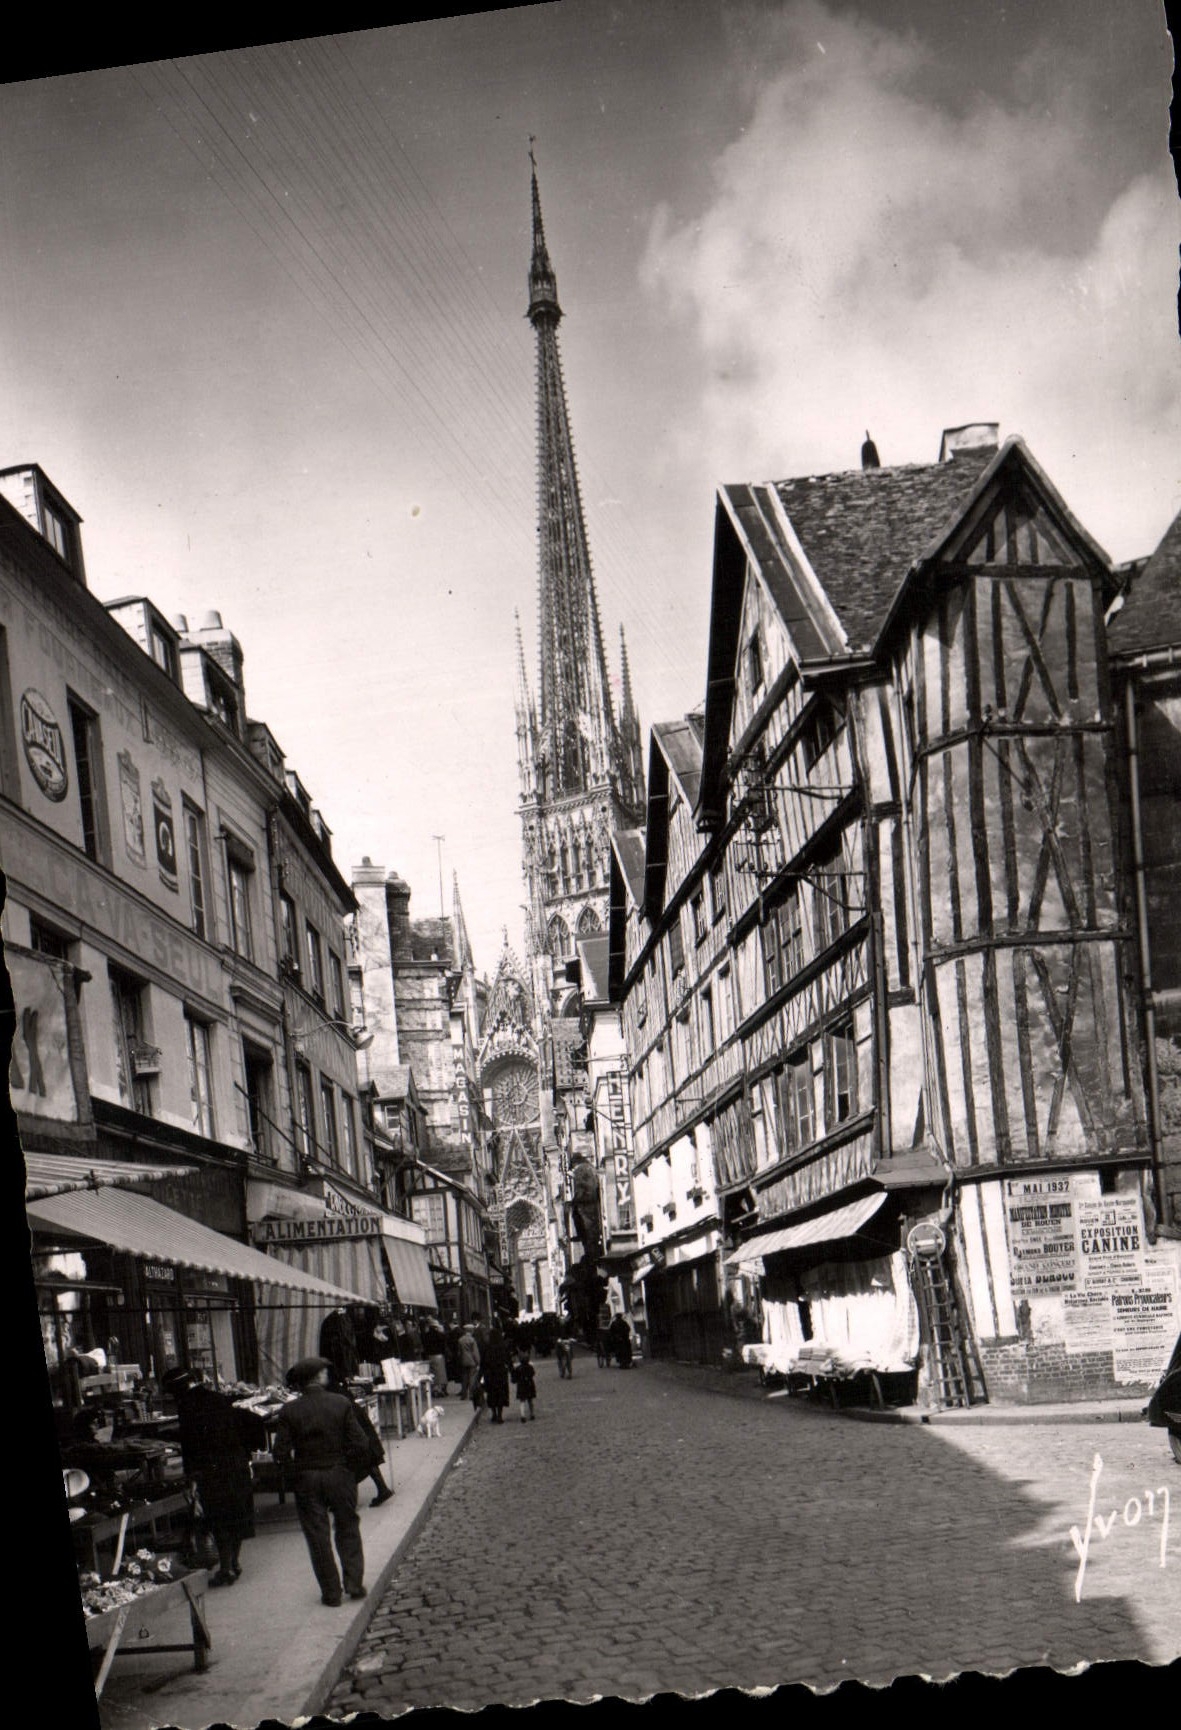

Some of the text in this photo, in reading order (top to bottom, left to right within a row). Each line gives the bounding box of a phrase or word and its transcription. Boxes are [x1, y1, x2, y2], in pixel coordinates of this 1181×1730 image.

[453, 1047, 472, 1143] MAGASIN
[1023, 1183, 1043, 1194] MAI
[1047, 1181, 1070, 1192] 1937
[265, 1217, 381, 1241] ALIMENTATION
[1034, 1219, 1062, 1227] ROUEN
[1081, 1226, 1138, 1239] EXPOSITION
[1082, 1236, 1140, 1254] CANINE
